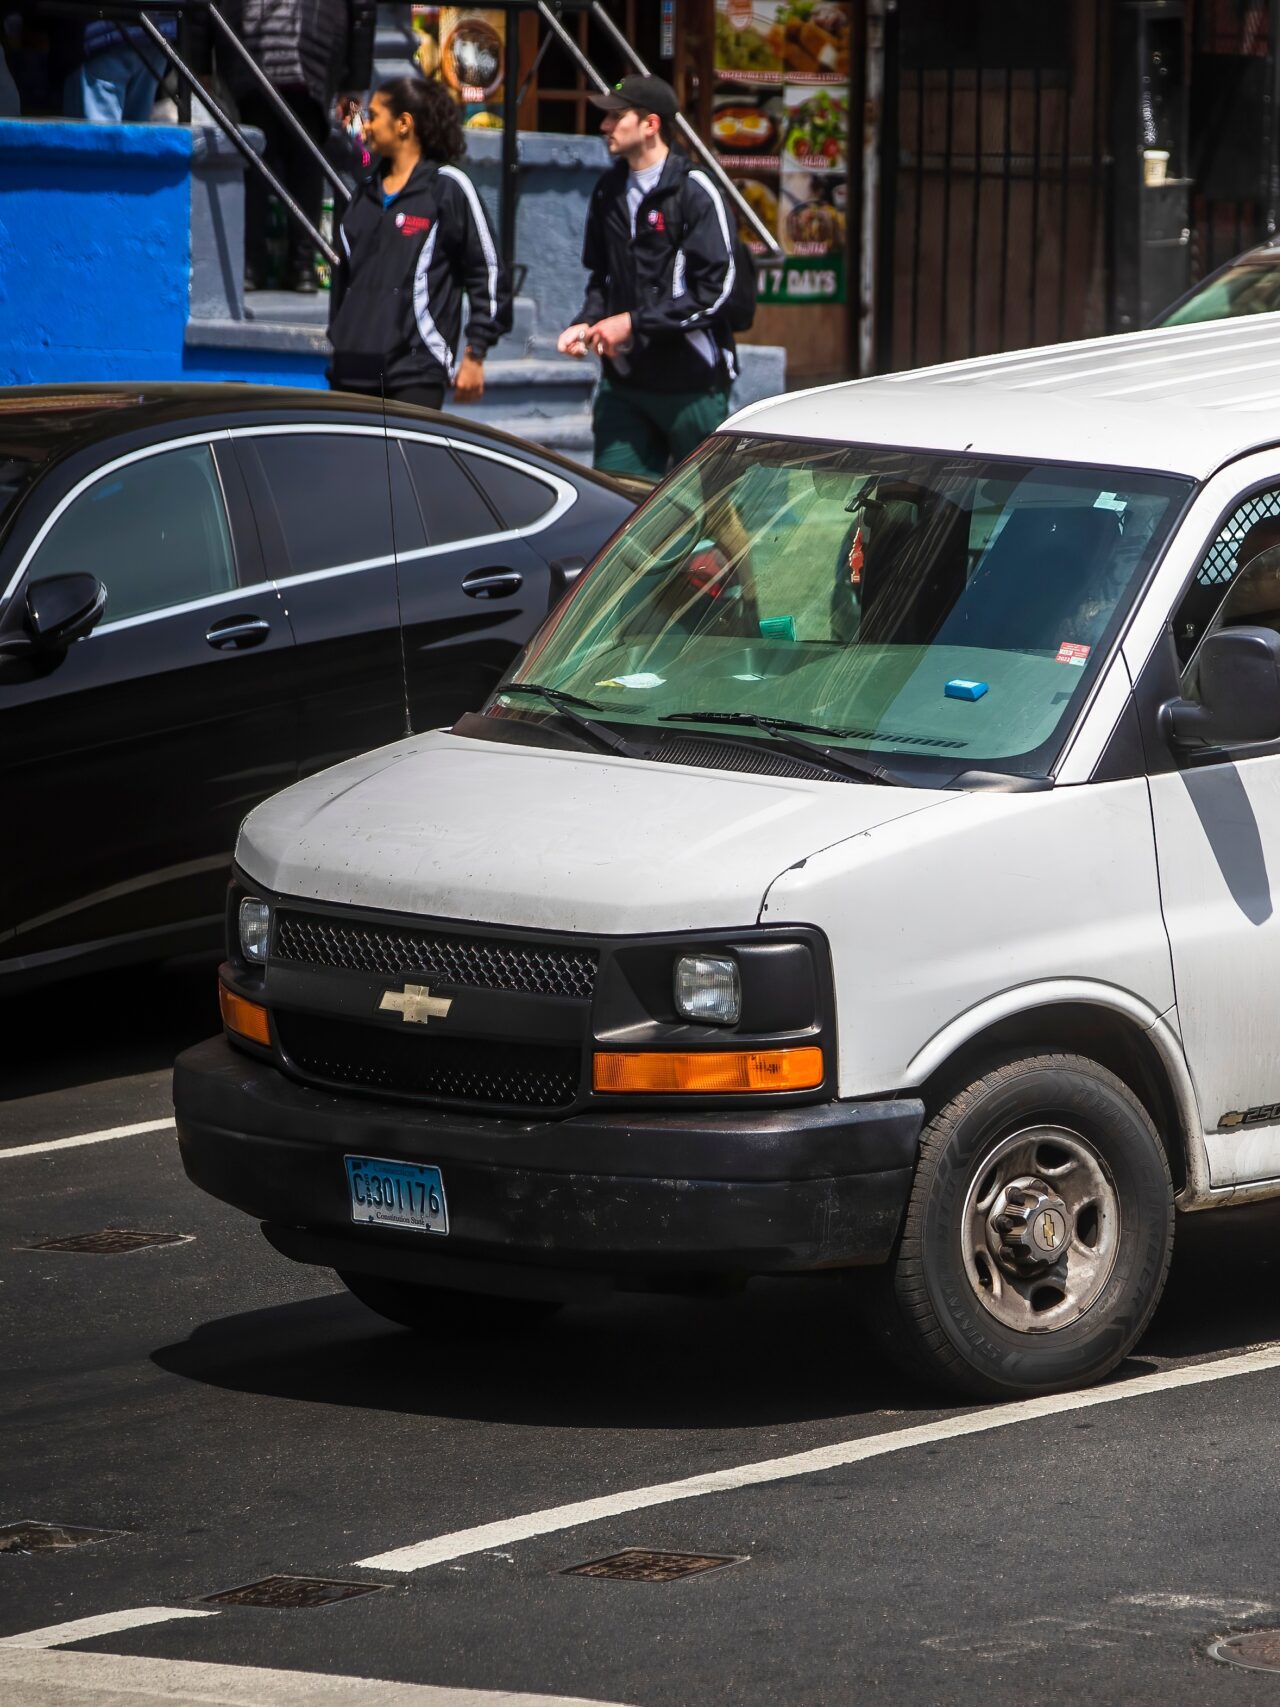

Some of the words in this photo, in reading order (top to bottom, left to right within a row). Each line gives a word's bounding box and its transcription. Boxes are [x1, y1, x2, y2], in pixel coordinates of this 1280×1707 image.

[768, 269, 783, 295] 7
[786, 269, 837, 295] DAYS
[376, 1211, 410, 1224] Constitution
[411, 1216, 425, 1226] State
